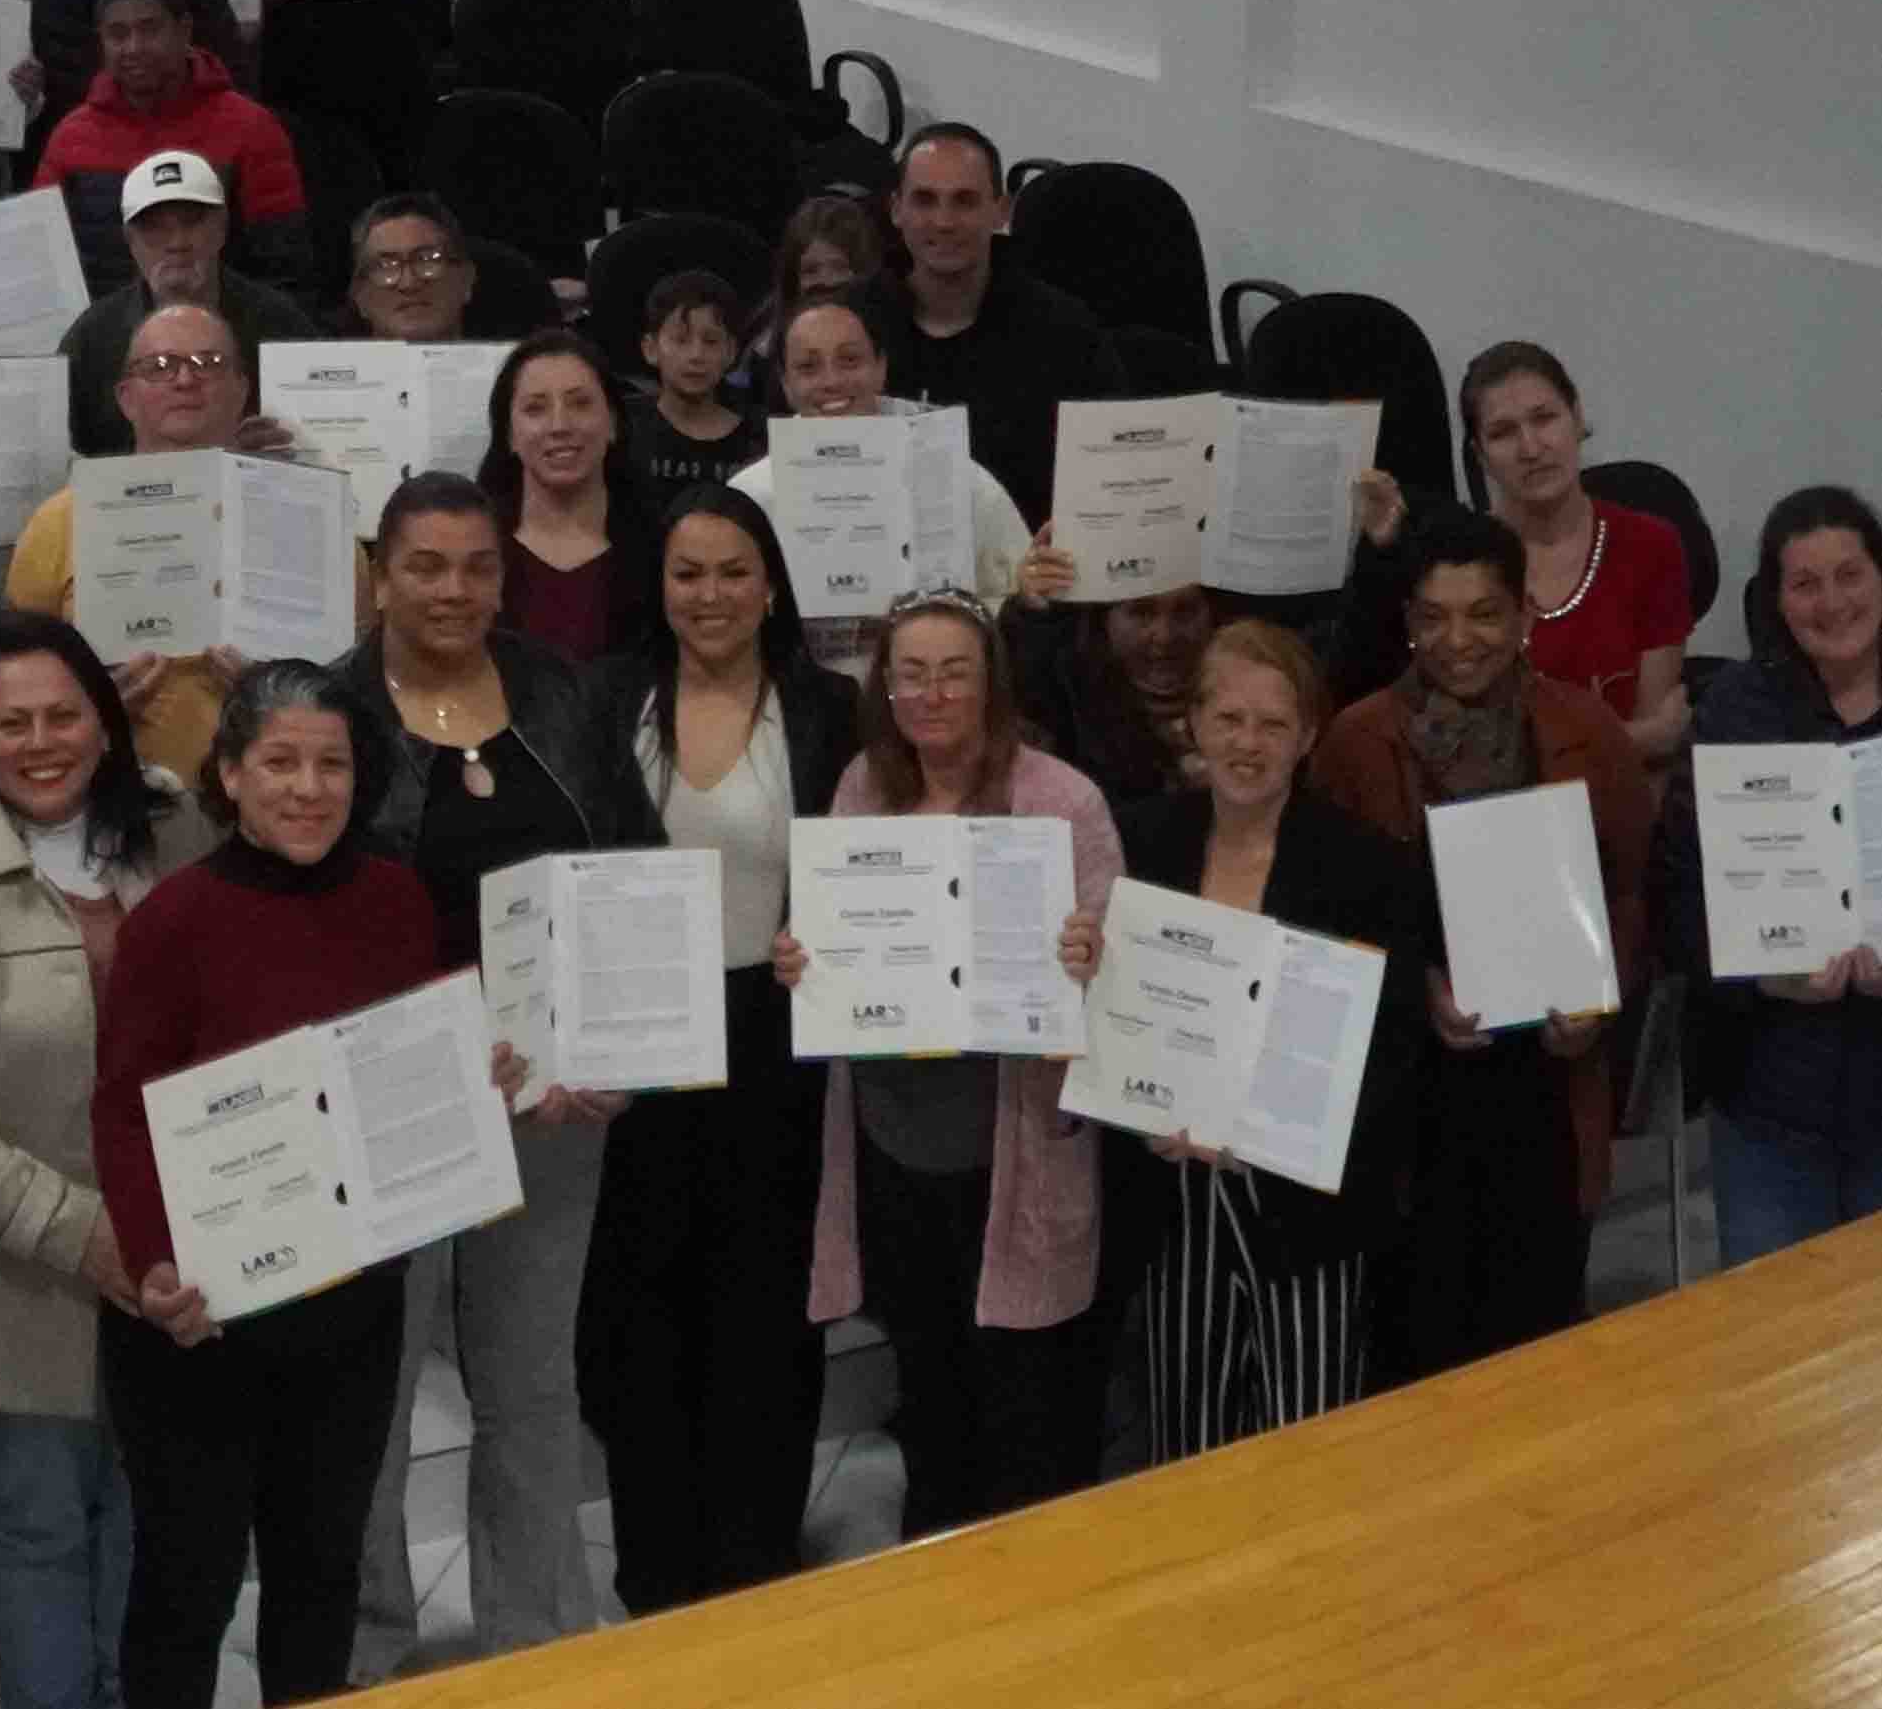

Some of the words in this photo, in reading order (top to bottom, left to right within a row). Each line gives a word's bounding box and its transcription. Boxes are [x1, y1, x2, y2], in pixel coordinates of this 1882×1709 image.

[853, 1004, 887, 1019] LAR
[1124, 1076, 1157, 1097] LAR
[241, 1250, 276, 1277] LAR
